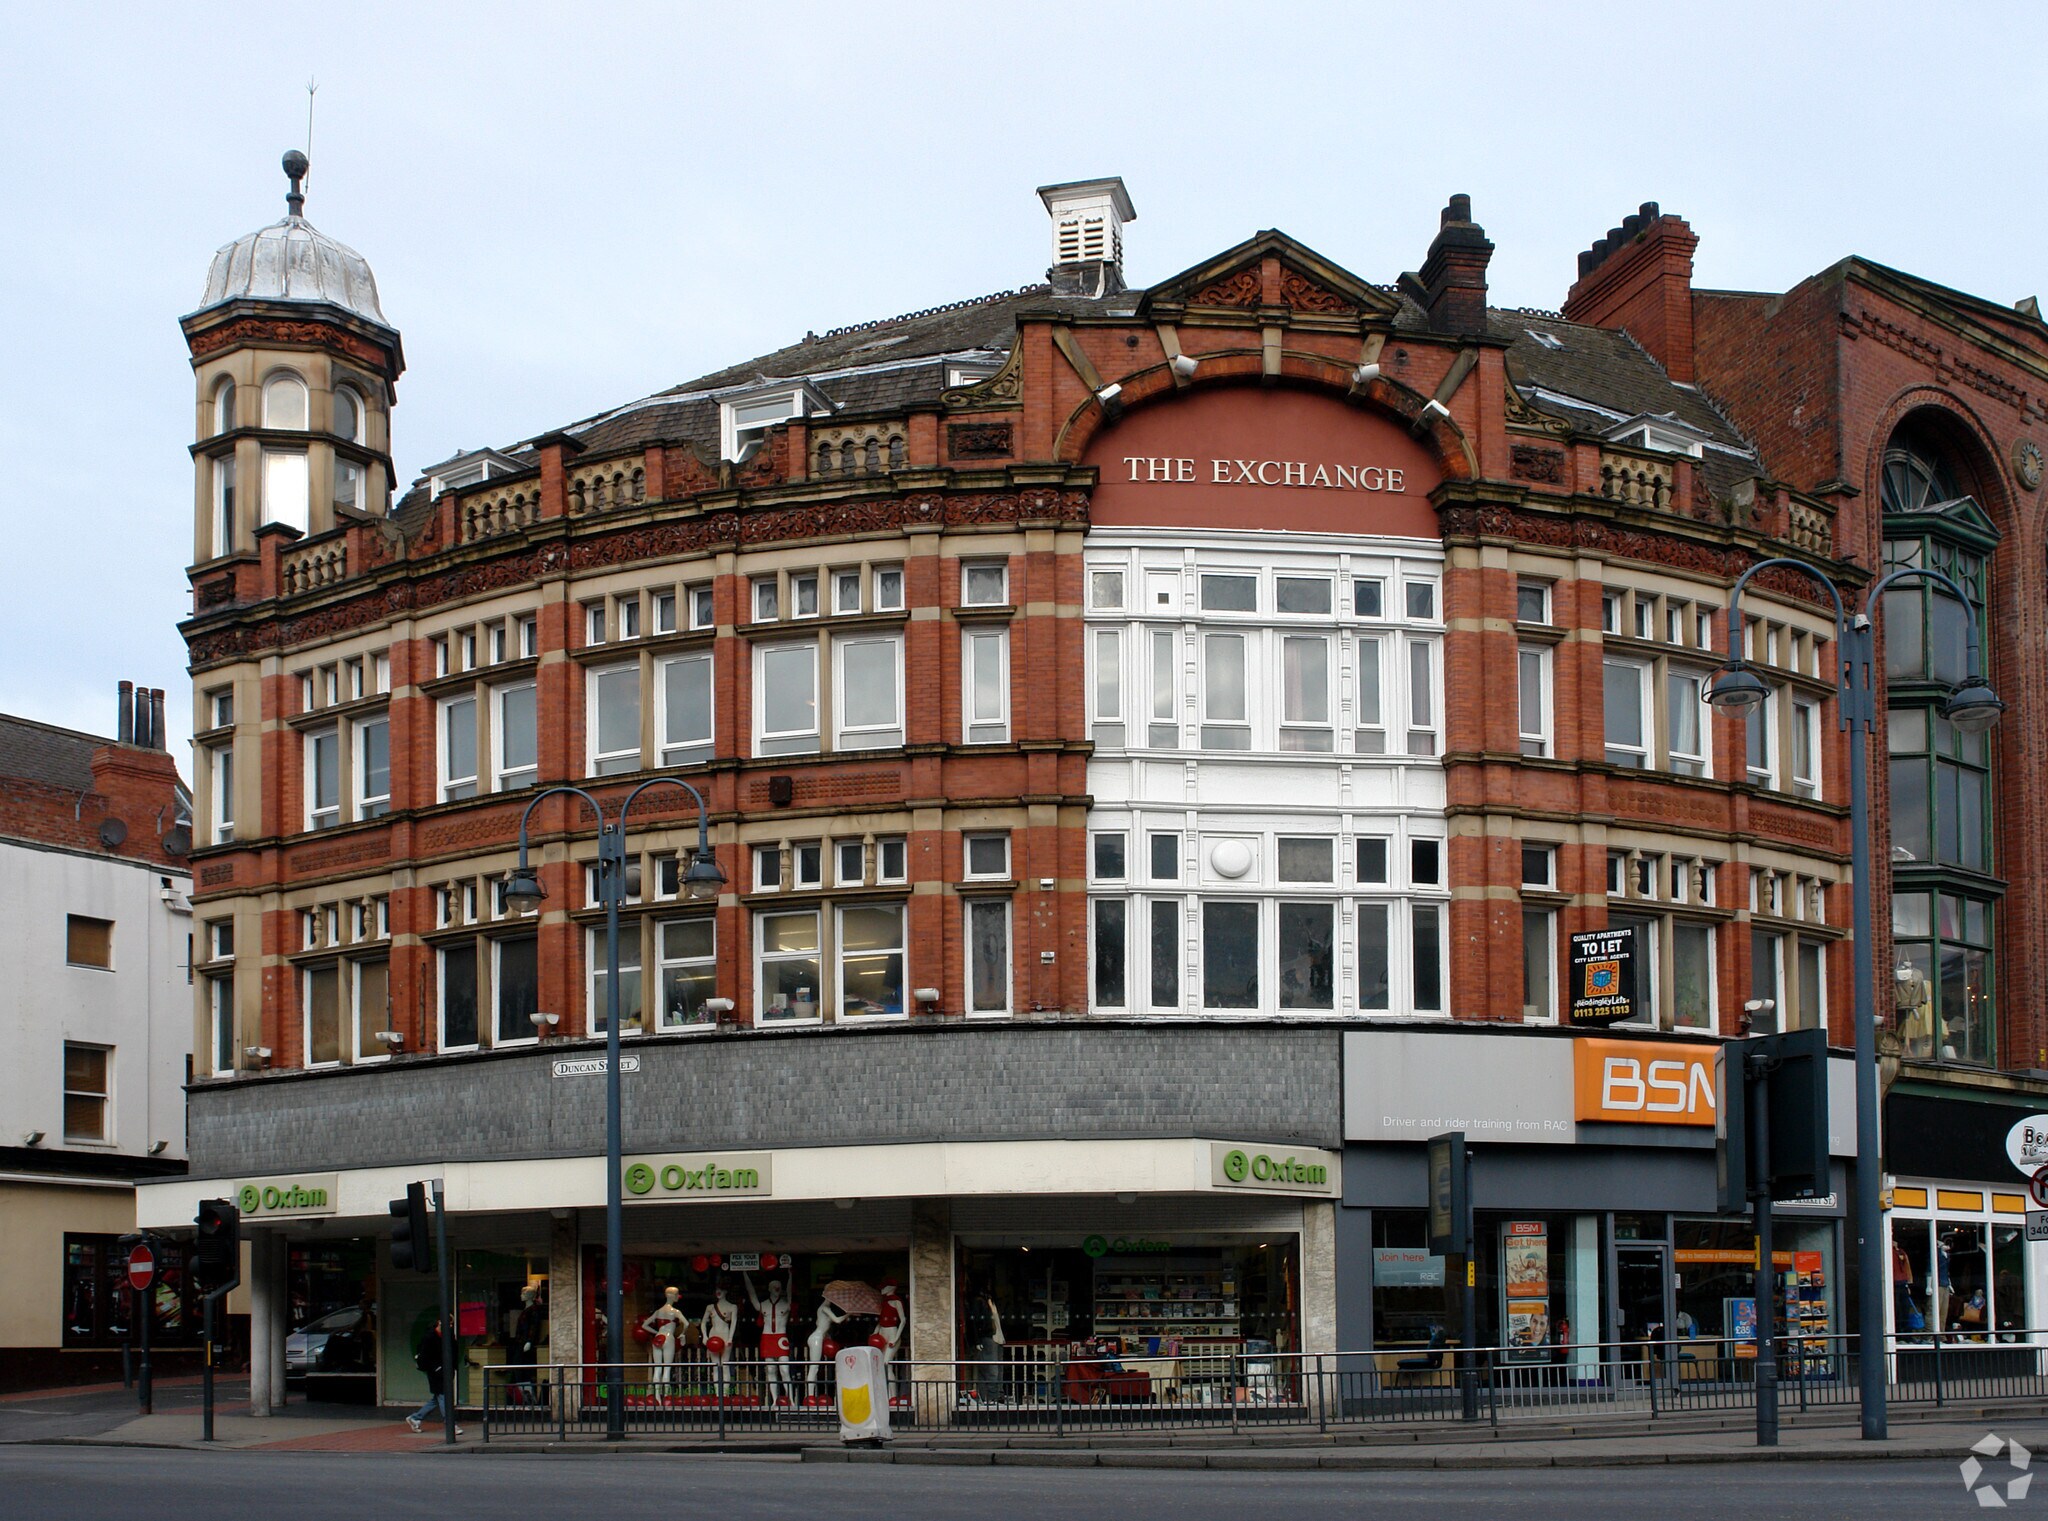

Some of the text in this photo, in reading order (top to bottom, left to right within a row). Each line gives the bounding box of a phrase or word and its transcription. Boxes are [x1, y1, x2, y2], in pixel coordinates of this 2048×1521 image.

[1123, 457, 1406, 493] THE EXCHANGE
[1573, 929, 1632, 942] QUALITY APARTMENTS
[1582, 939, 1622, 955] TO LET
[1574, 1005, 1630, 1018] 0113 225 1313
[561, 1060, 631, 1074] DUNCAN SET
[1383, 1116, 1567, 1131] Driver and rider training from RAC
[662, 1163, 758, 1190] Oxfam
[1252, 1154, 1327, 1185] Oxfam
[262, 1184, 327, 1209] Oxfam
[1515, 1224, 1539, 1233] BSM
[1113, 1238, 1171, 1252] Oxfam
[1506, 1237, 1547, 1246] Get there
[1379, 1252, 1424, 1262] Join here
[1738, 1301, 1747, 1316] 5
